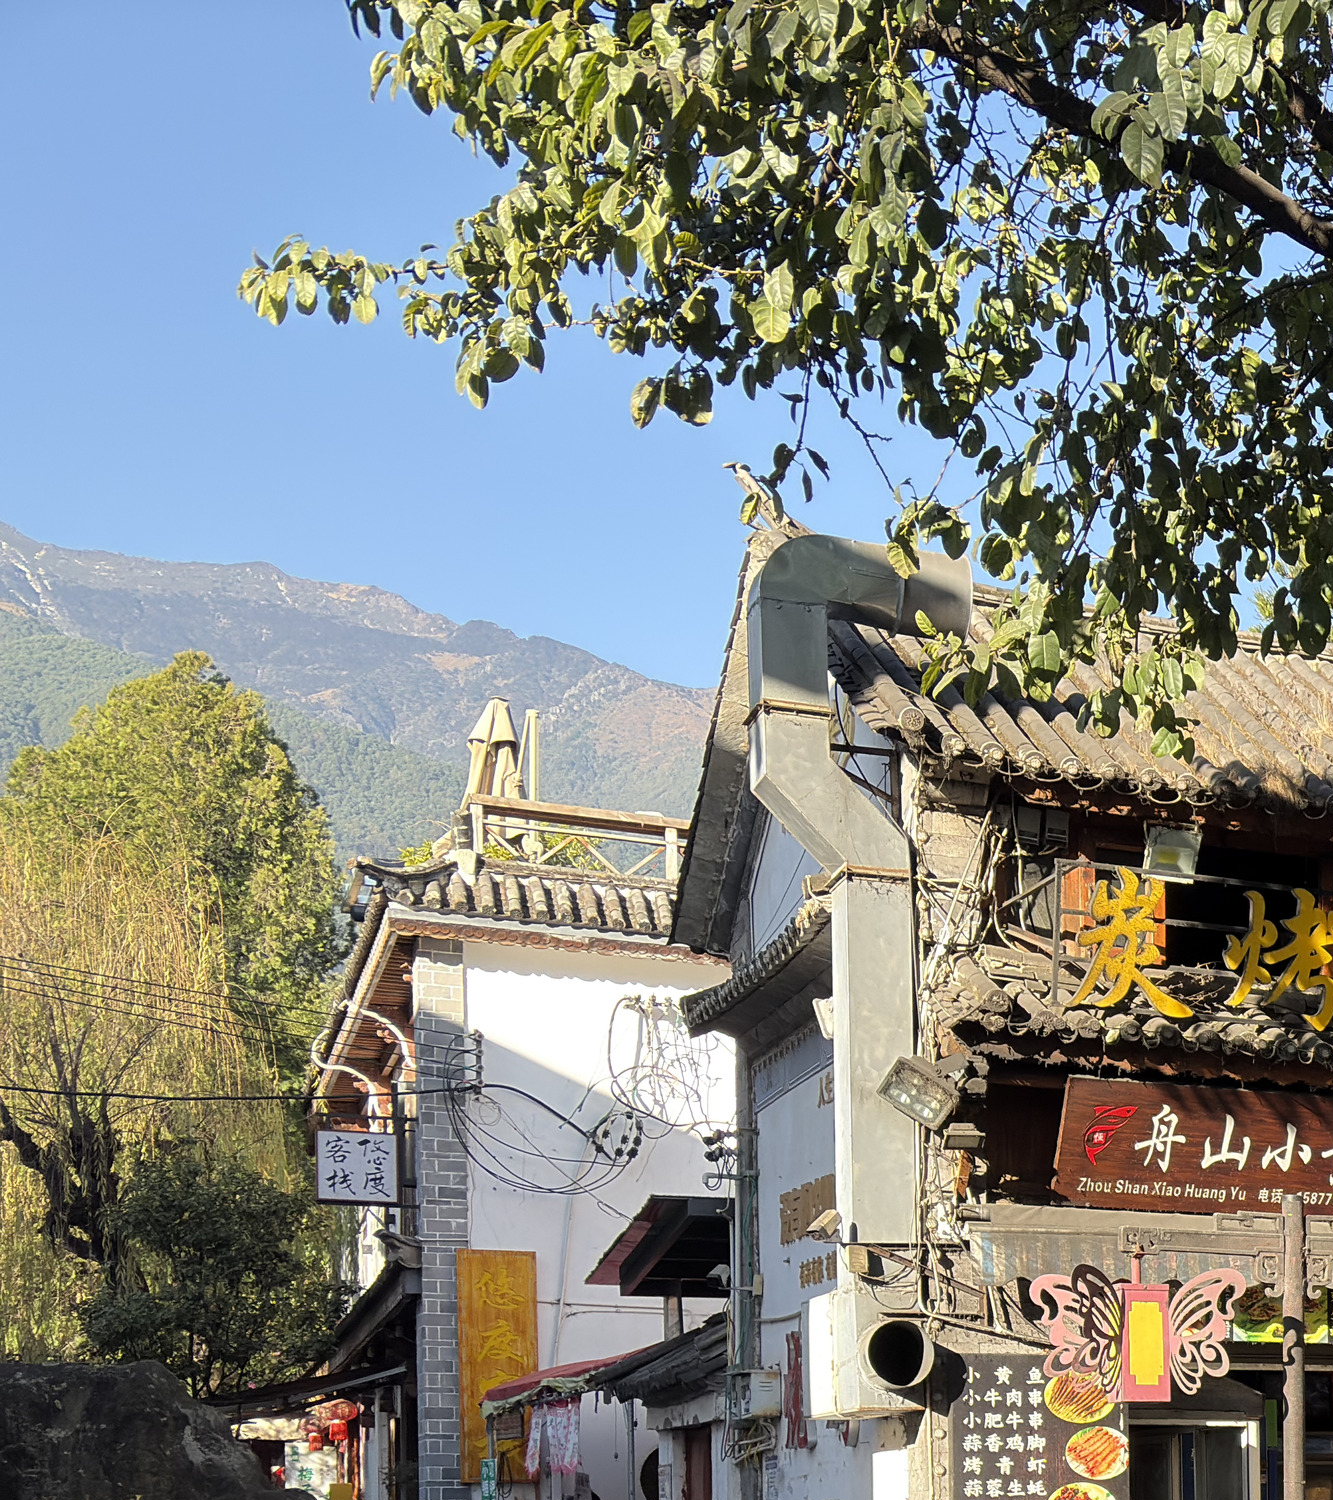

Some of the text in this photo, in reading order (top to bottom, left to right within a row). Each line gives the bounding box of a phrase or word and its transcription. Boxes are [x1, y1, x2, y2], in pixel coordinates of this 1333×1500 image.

[325, 1136, 356, 1196] 客栈
[1077, 1178, 1247, 1202] Zhou Shan Xiao Huang Yu
[963, 1366, 1045, 1385] 小黄鱼
[963, 1389, 1044, 1407] 小牛肉串
[963, 1411, 1044, 1430] 小肥牛串
[962, 1434, 1047, 1453] 蒜香鸡脚
[963, 1456, 1047, 1475] 烤青虾
[963, 1479, 1048, 1498] 蒜蓉生蚝
